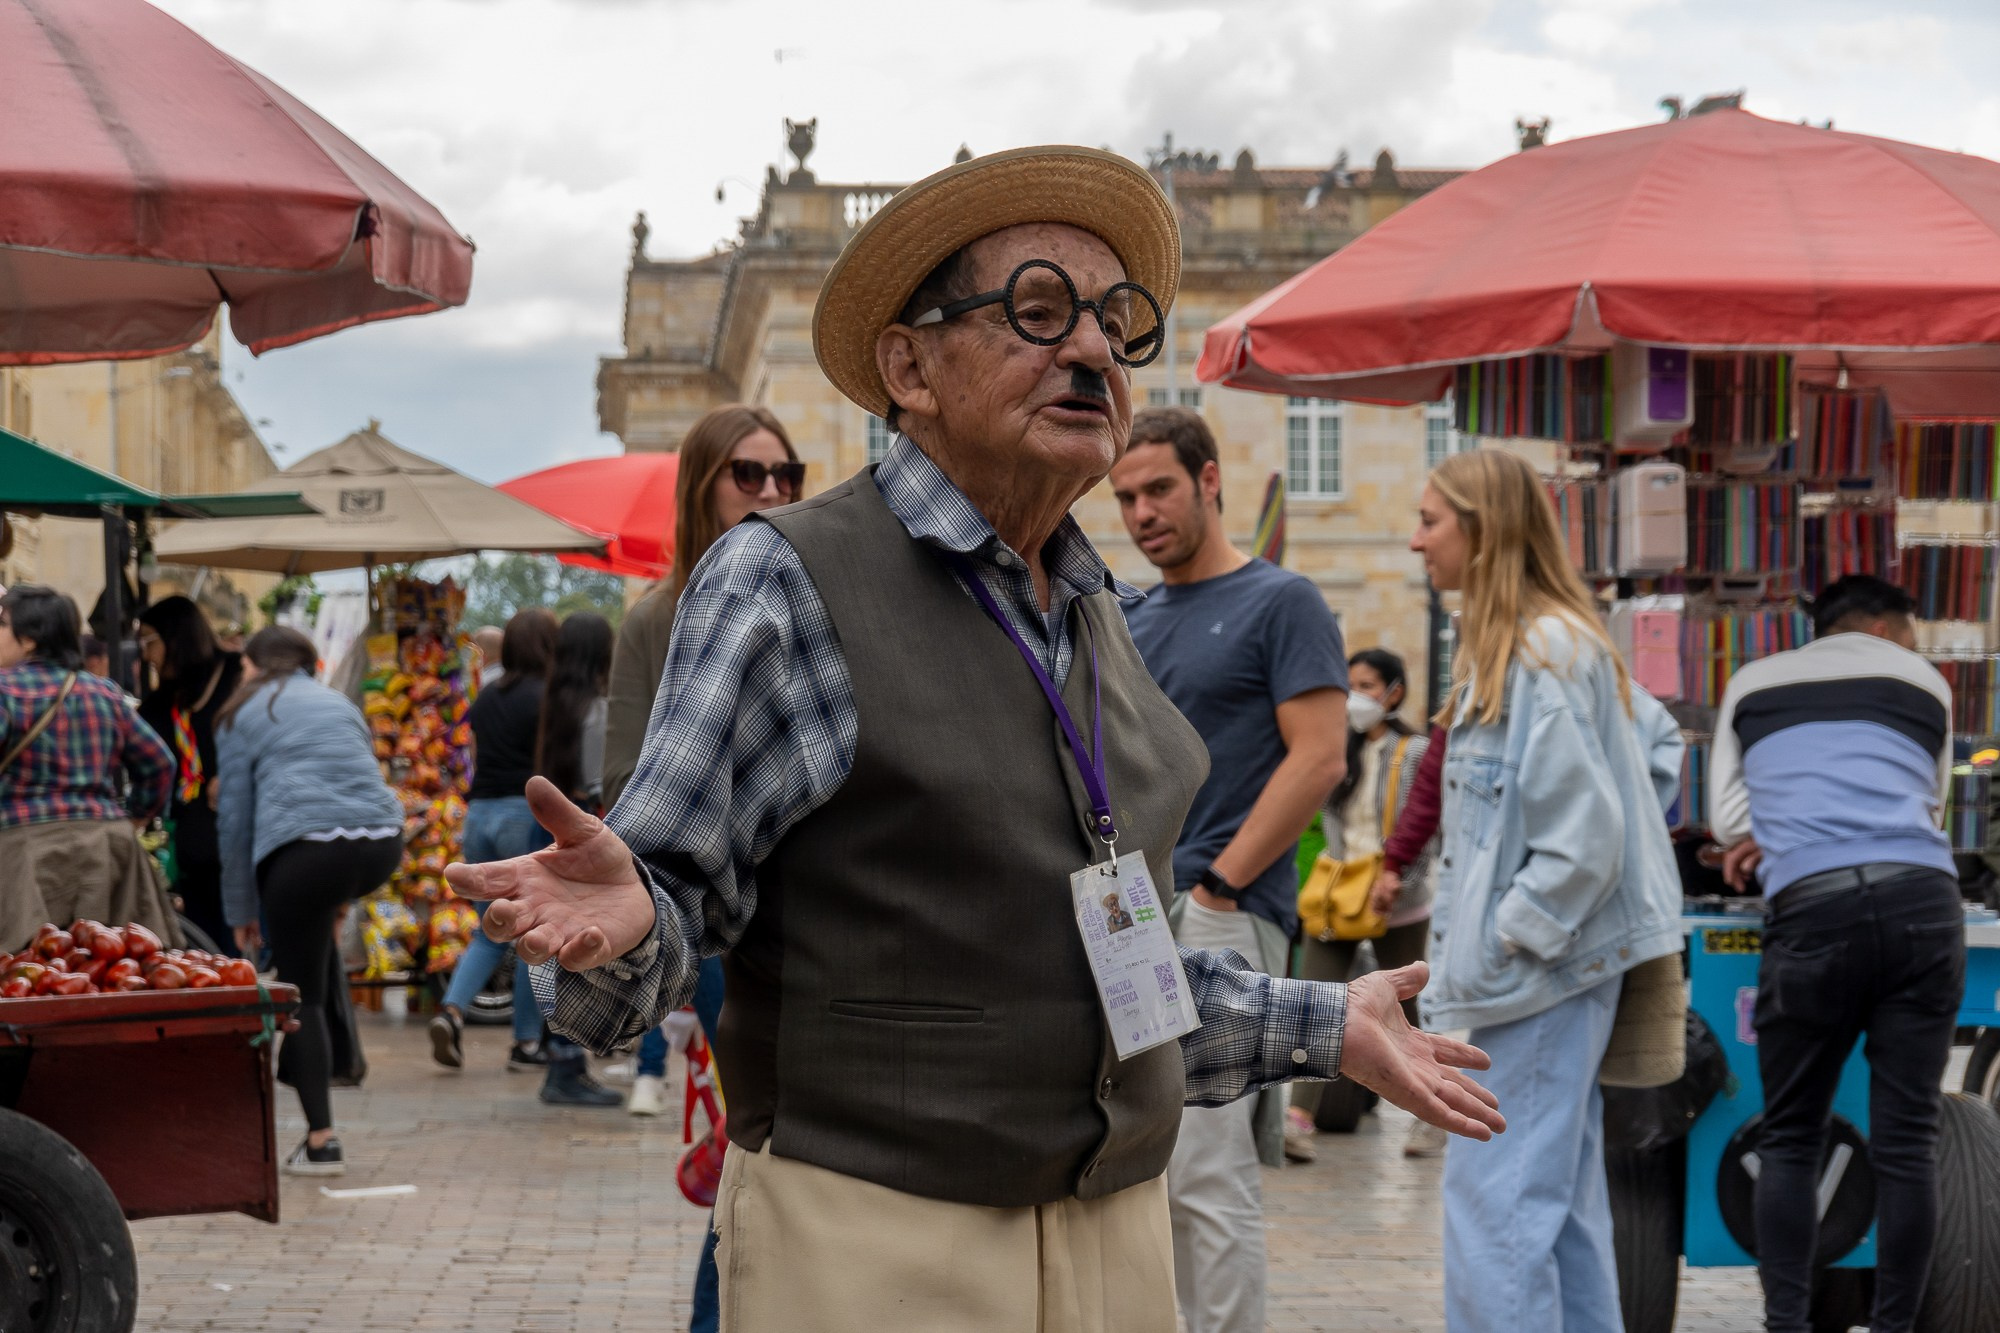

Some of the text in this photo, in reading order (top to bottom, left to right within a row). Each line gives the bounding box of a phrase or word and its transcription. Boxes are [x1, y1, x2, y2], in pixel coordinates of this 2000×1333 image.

[1126, 885, 1143, 907] ARTE
[1087, 930, 1096, 943] SOY
[1093, 926, 1102, 941] DEL
